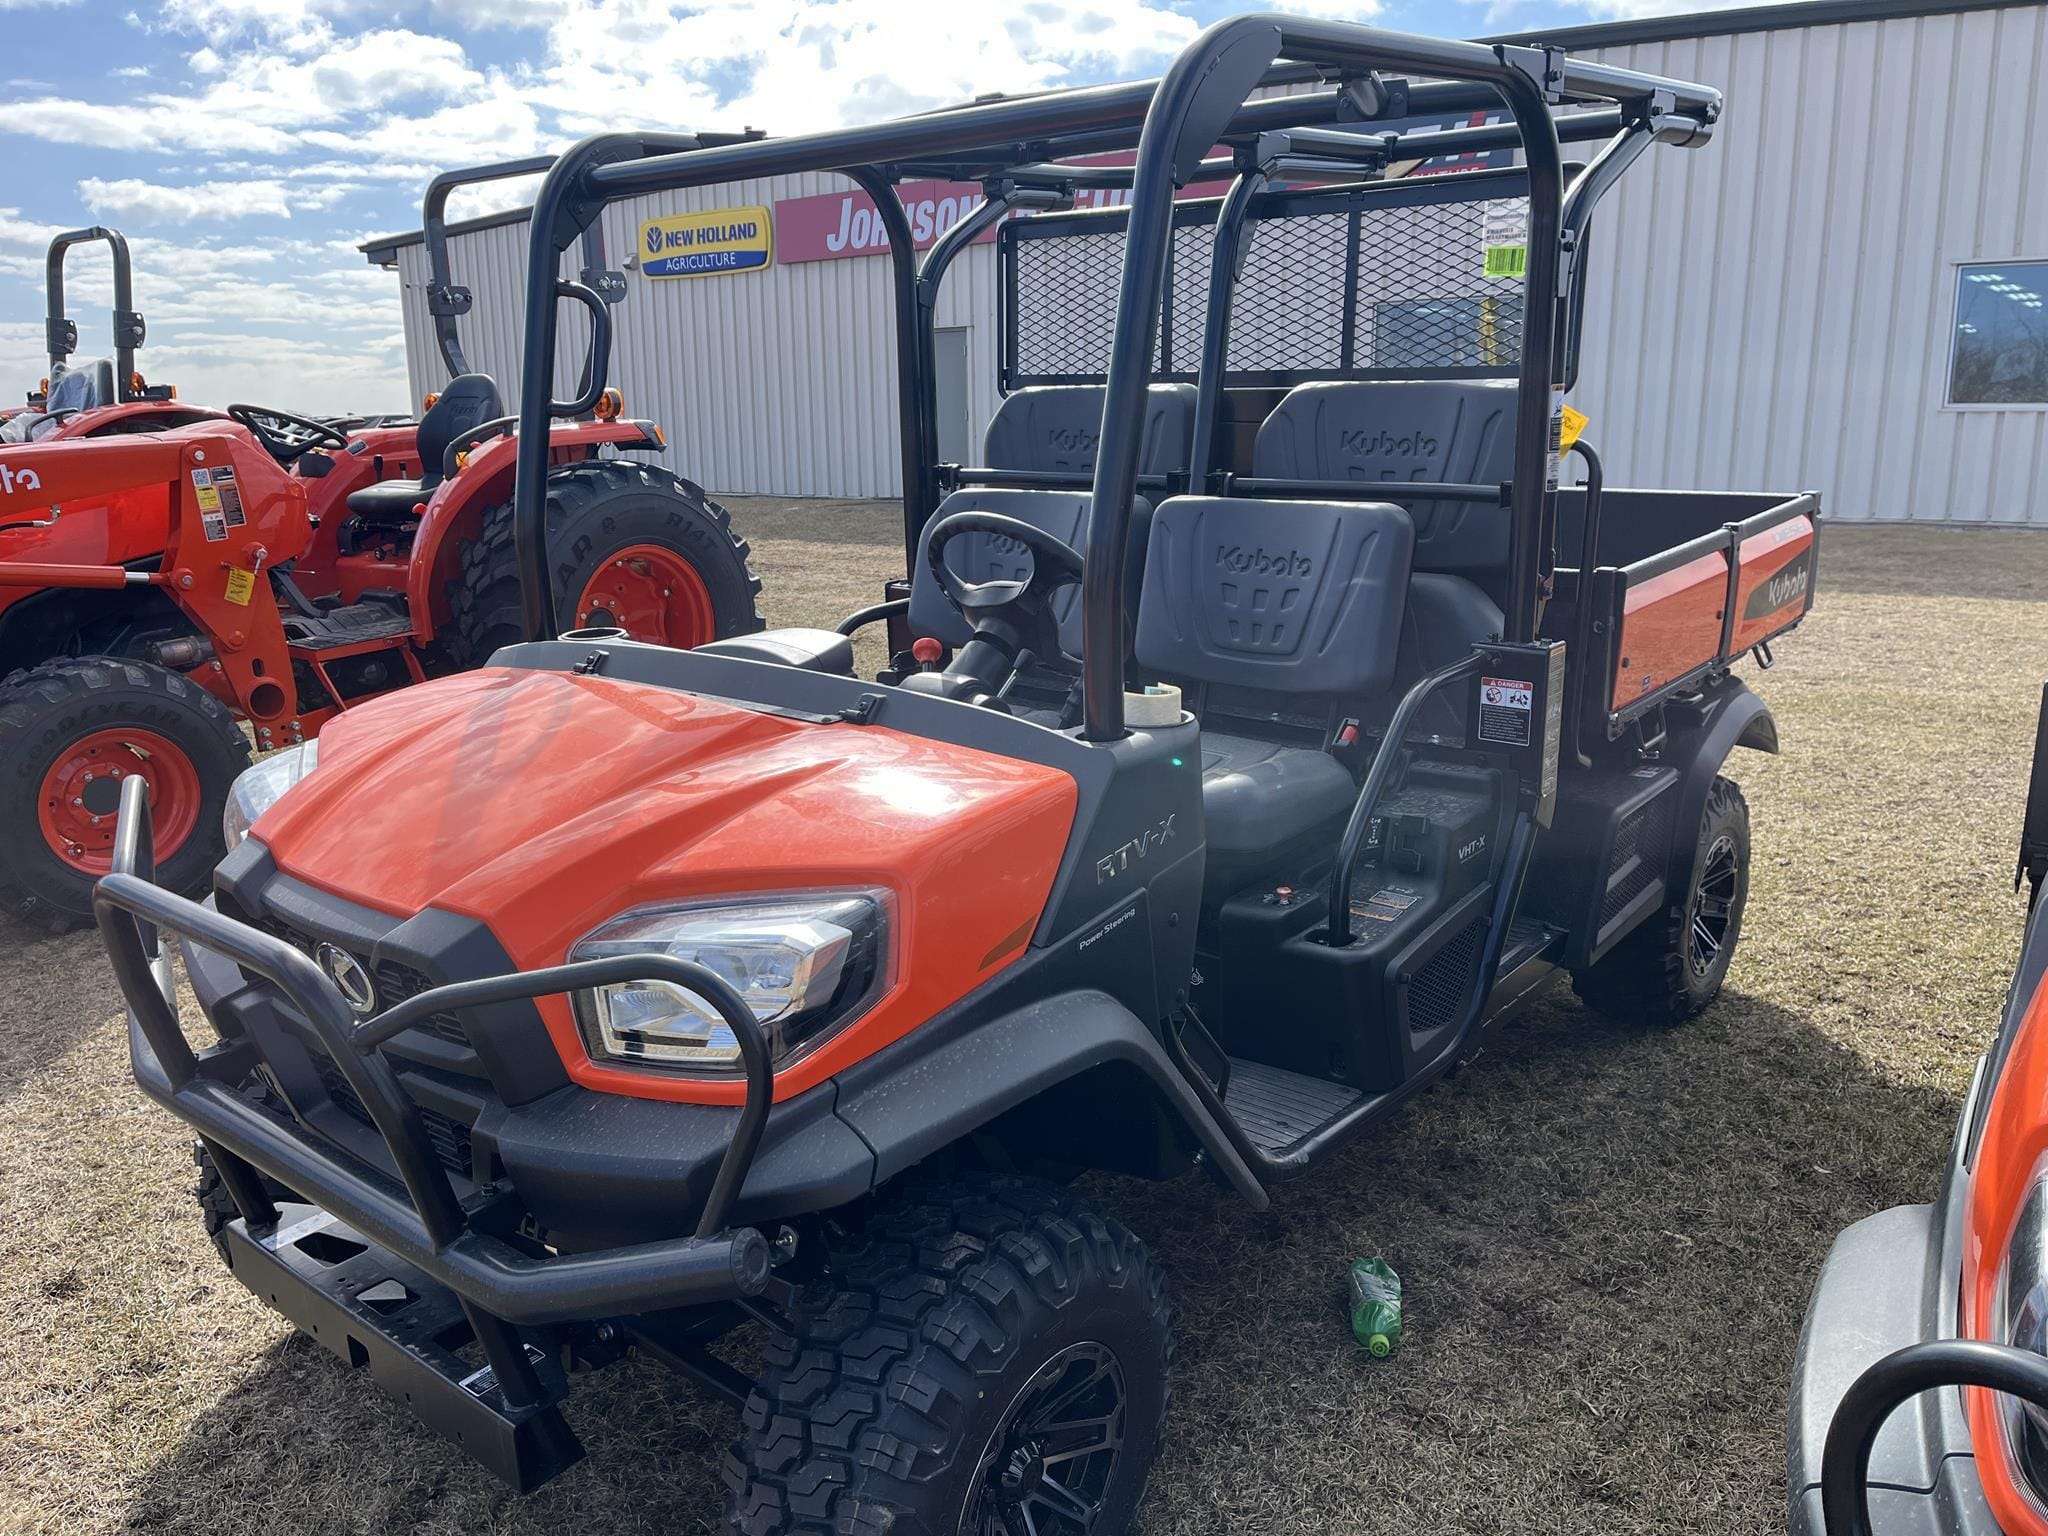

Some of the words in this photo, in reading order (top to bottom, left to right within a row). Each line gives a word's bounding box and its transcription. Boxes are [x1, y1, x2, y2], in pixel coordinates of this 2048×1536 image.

[665, 229, 694, 248] NEW
[697, 222, 757, 244] HOLLAND
[826, 194, 982, 252] JOHSO
[665, 252, 736, 271] AGRICULTURE
[1341, 430, 1439, 457] Kubota
[1216, 545, 1313, 578] Kubota
[1768, 566, 1807, 606] Kubota
[1497, 681, 1524, 689] DANGER
[1097, 814, 1175, 885] RTV-X
[1458, 832, 1486, 859] VHT-X
[1079, 930, 1104, 950] Power
[1104, 908, 1135, 934] Steering
